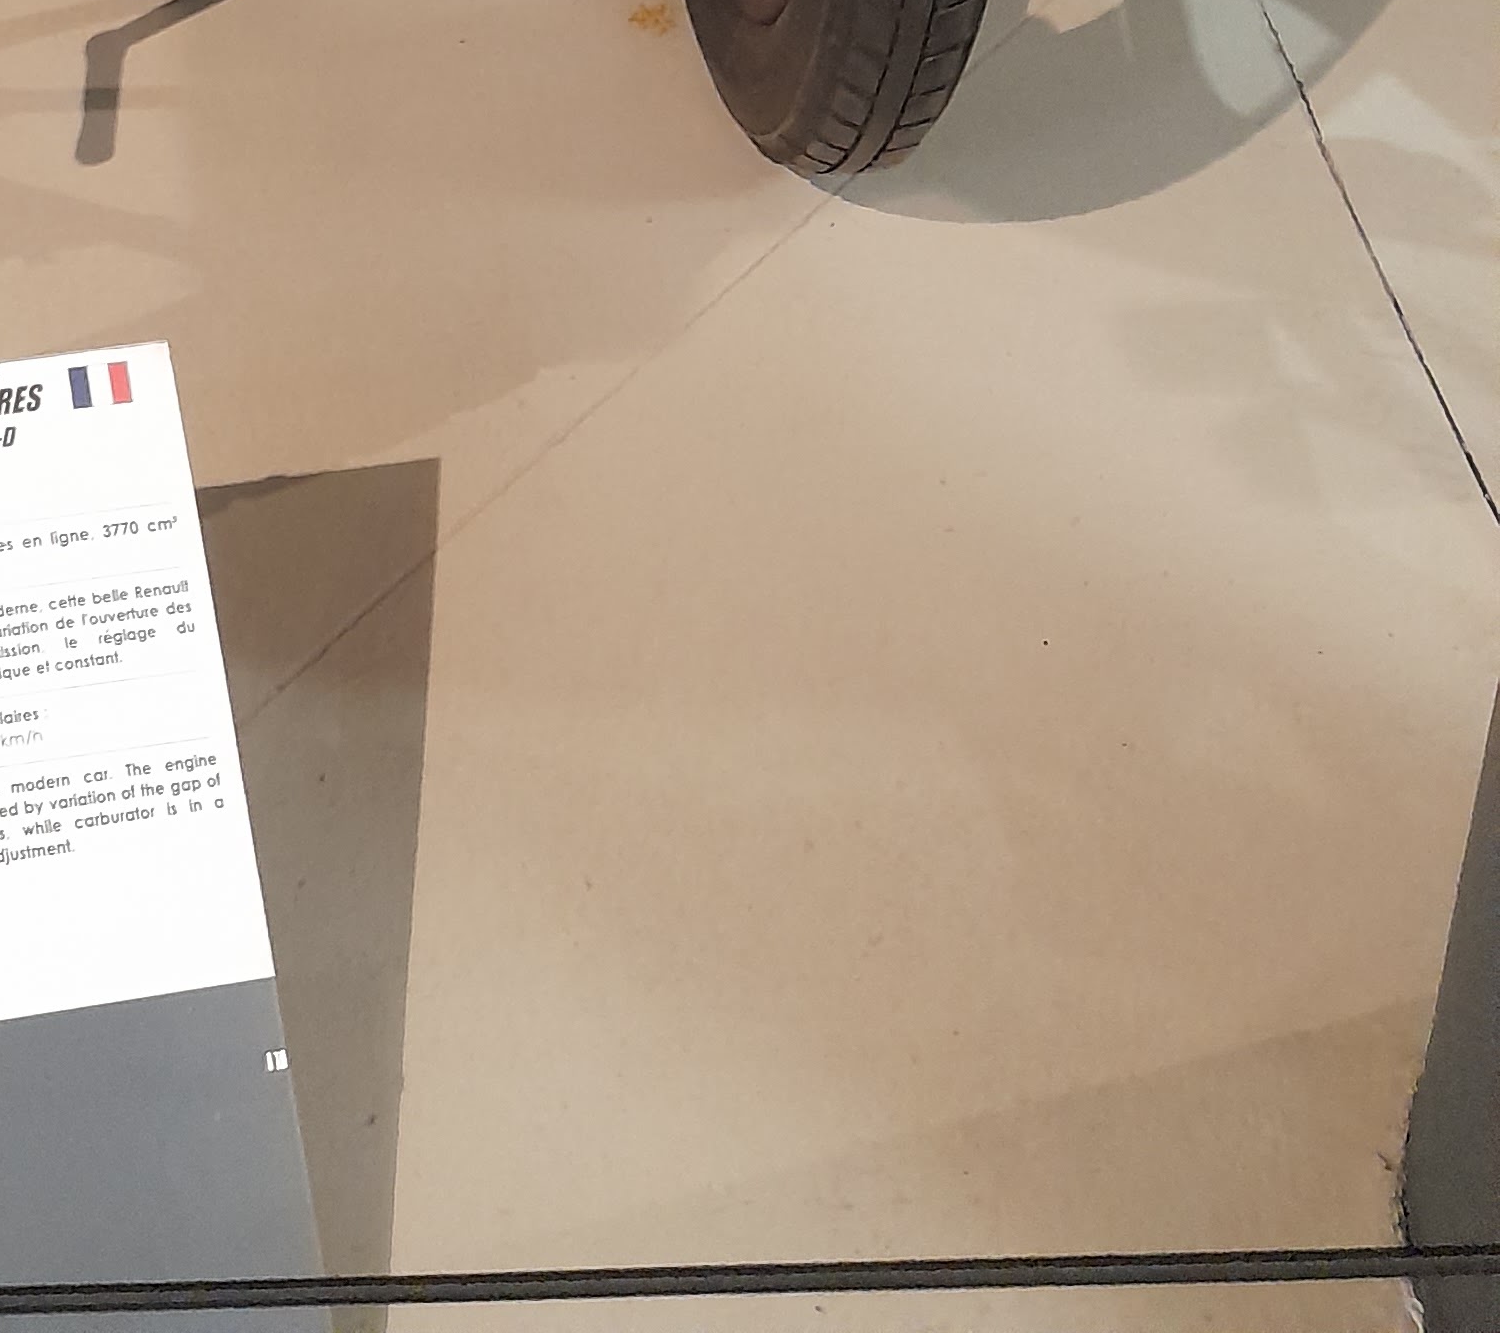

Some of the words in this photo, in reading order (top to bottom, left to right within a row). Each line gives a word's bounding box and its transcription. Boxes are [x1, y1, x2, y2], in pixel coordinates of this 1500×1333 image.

[21, 536, 43, 549] en
[102, 520, 140, 539] 3770
[47, 594, 87, 611] cette
[91, 588, 129, 605] belle
[134, 579, 189, 599] Renault
[55, 615, 76, 630] de
[81, 607, 160, 626] l'ouverture
[165, 601, 193, 616] des
[63, 636, 78, 649] le
[98, 627, 157, 646] réglage
[175, 620, 196, 635] du
[36, 660, 50, 675] et
[54, 649, 124, 672] constant.
[10, 775, 71, 794] modern
[124, 762, 152, 777] The
[164, 754, 217, 773] engine
[23, 800, 44, 816] by
[48, 790, 117, 810] variation
[120, 784, 136, 801] of
[139, 783, 165, 798] the
[170, 779, 202, 797] gap
[206, 771, 221, 788] of
[21, 818, 63, 836] while
[74, 806, 155, 830] carburator
[166, 801, 178, 816] is
[188, 798, 203, 813] in
[213, 797, 225, 809] a
